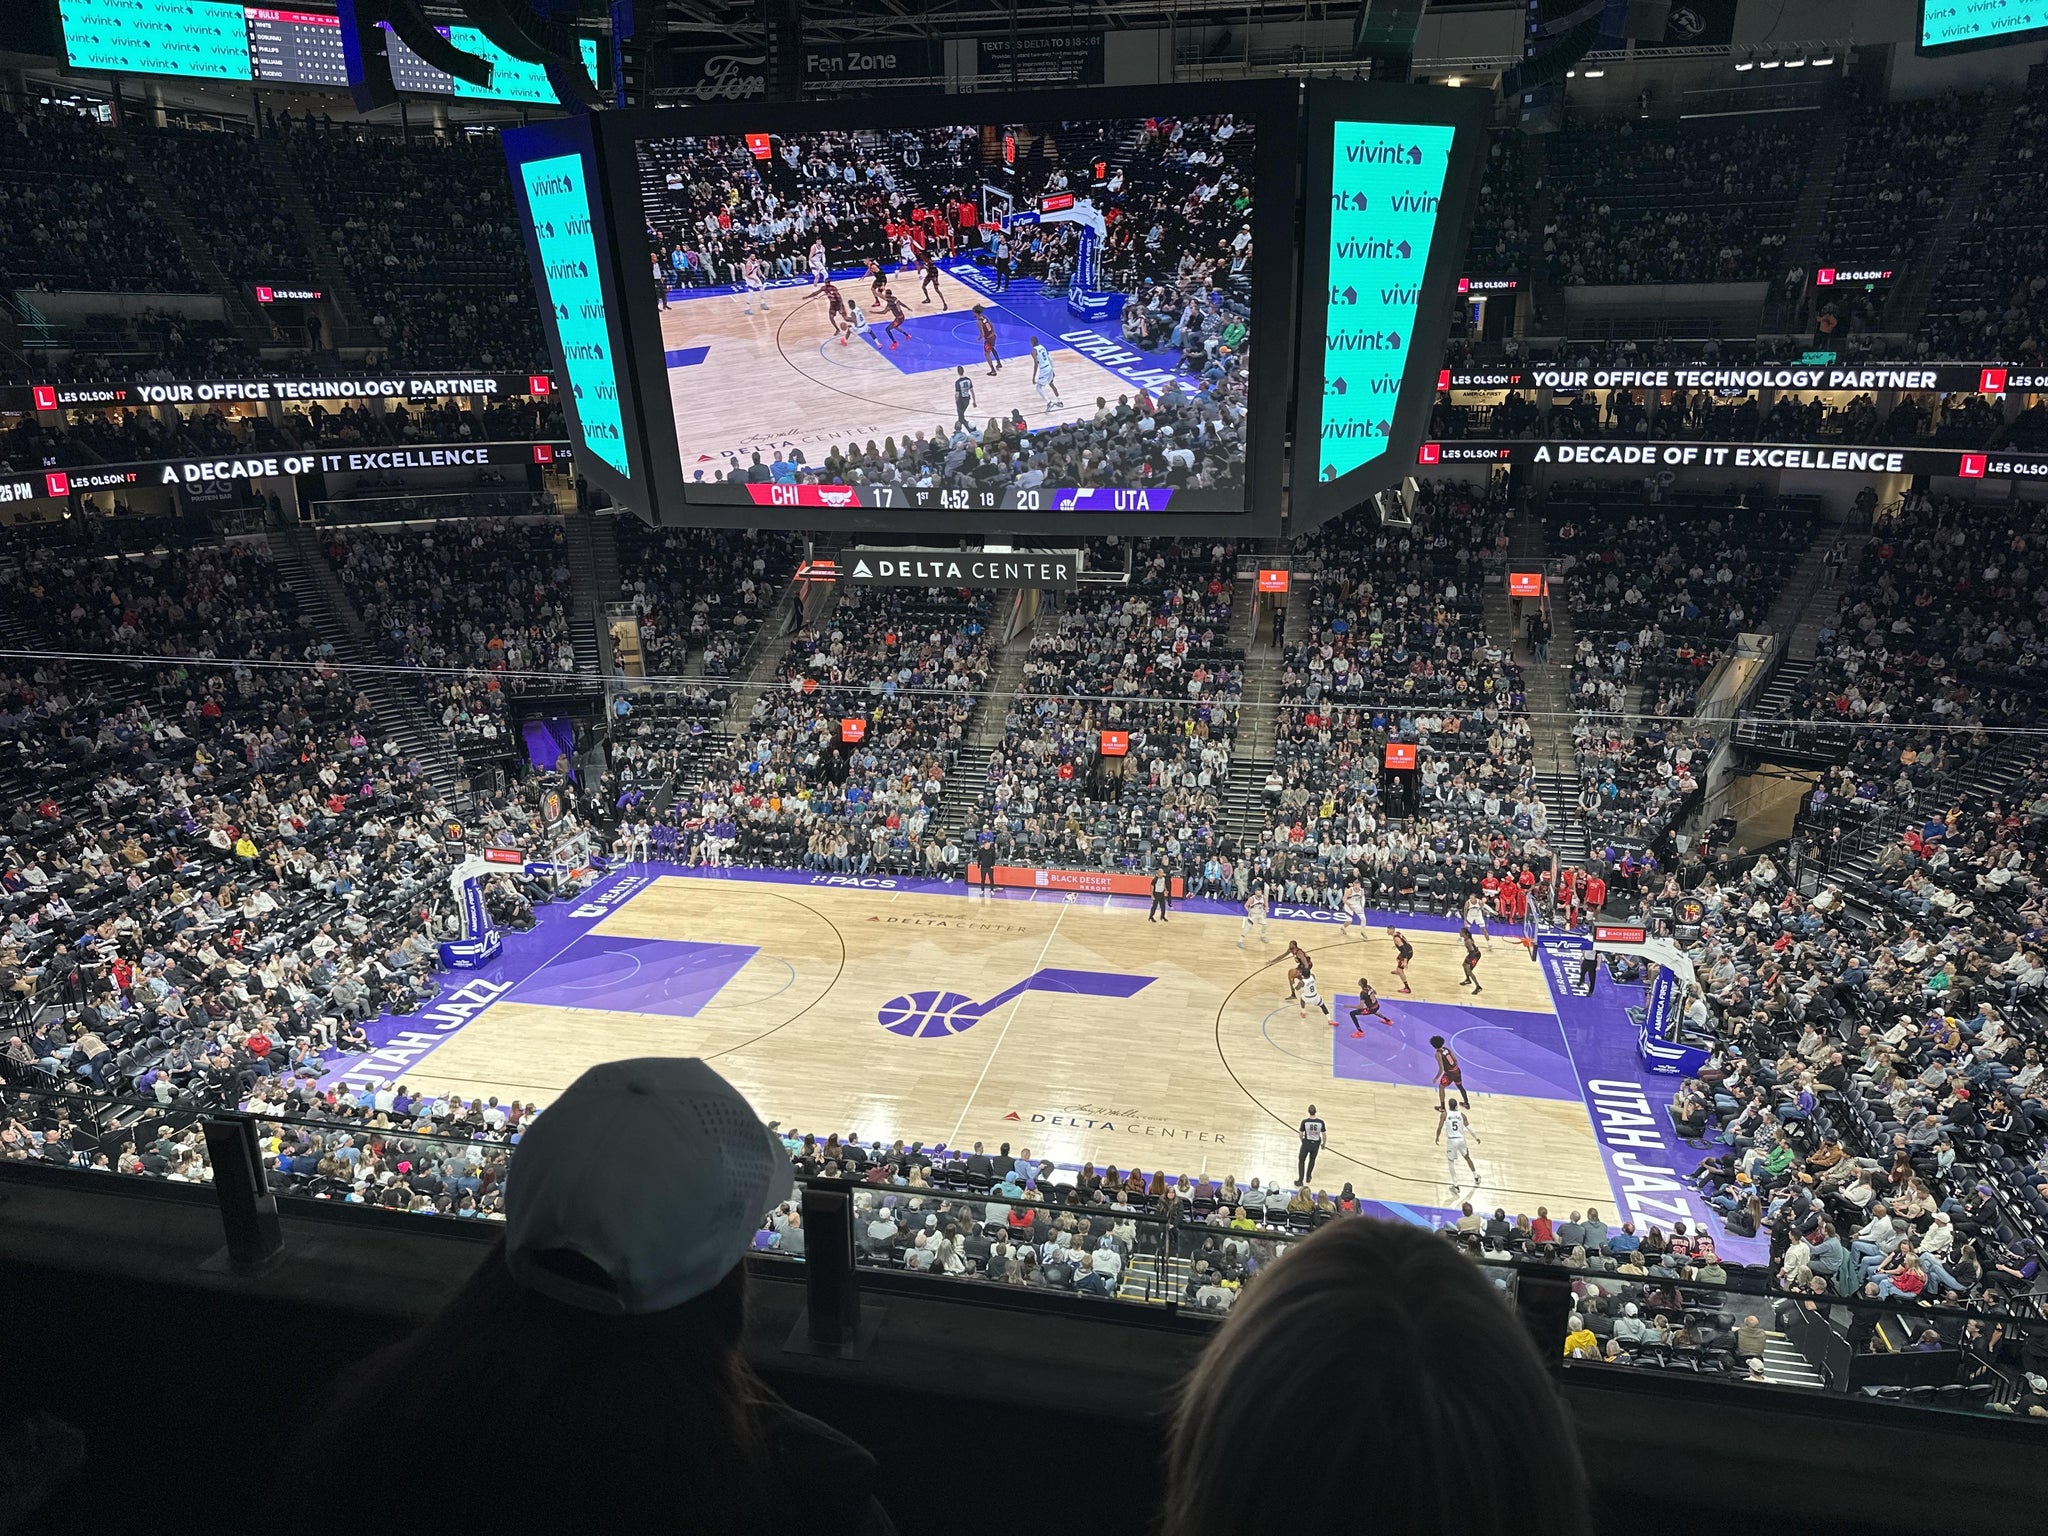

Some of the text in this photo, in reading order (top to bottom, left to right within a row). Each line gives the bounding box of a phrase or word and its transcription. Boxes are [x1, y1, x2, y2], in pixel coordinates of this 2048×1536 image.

[155, 3, 184, 14] vivint
[204, 8, 233, 18] vivint
[1967, 1, 1997, 13] vivint
[81, 15, 113, 26] vivint
[258, 10, 279, 19] BULLS
[133, 20, 164, 31] vivint
[1991, 16, 2021, 28] vivint
[183, 24, 213, 35] vivint
[1942, 24, 1971, 37] vivint
[111, 36, 142, 48] vivint
[162, 41, 192, 52] vivint
[982, 39, 1064, 51] TEXT SS DELTA TO
[211, 45, 241, 56] vivint
[88, 54, 120, 65] vivint
[139, 58, 170, 69] vivint
[807, 53, 897, 73] Fan Zone
[189, 62, 219, 73] vivint
[511, 88, 534, 97] vivint
[1347, 140, 1404, 164] vivint
[532, 174, 563, 197] vivint
[1337, 236, 1393, 258] vivint
[546, 259, 578, 280] vivint
[1836, 272, 1851, 280] LES
[1853, 271, 1882, 279] OLSON
[1326, 328, 1383, 350] vivint
[1059, 329, 1143, 366] UTAH
[1452, 375, 1472, 385] LES
[1473, 375, 1508, 385] OLSON
[1510, 375, 1521, 384] IT
[1532, 371, 1588, 387] YOUR
[1593, 371, 1668, 387] OFFICE
[1674, 370, 1824, 388] TECHNOLOGY
[1829, 371, 1937, 389] PARTNER
[2008, 376, 2031, 386] LES
[58, 392, 77, 403] LES
[79, 391, 114, 401] OLSON
[116, 391, 127, 399] IT
[137, 386, 194, 402] YOUR
[198, 383, 269, 400] OFFICE
[274, 380, 405, 398] TECHNOLOGY
[411, 379, 497, 395] PARTNER
[720, 440, 794, 458] DELTA
[802, 426, 881, 443] CENTER
[1442, 450, 1461, 458] LES
[1463, 450, 1498, 459] OLSON
[1500, 450, 1510, 458] IT
[1534, 446, 1551, 462] A
[1558, 446, 1656, 464] DECADE
[1663, 448, 1698, 465] OF
[1704, 449, 1728, 465] IT
[1735, 449, 1903, 472] EXCELLENCE
[1988, 462, 2011, 473] LES
[14, 482, 33, 500] PM
[70, 478, 89, 488] LES
[91, 474, 125, 486] OLSON
[126, 473, 137, 482] IT
[162, 465, 181, 484] A
[184, 459, 279, 483] DECADE
[284, 457, 315, 475] OF
[321, 455, 341, 472] IT
[350, 449, 489, 470] EXCELLENCE
[555, 450, 572, 458] LES
[191, 493, 219, 502] PROTEIN
[771, 486, 1149, 510] CHI 17 1ST 4:52 18 20 UTA
[879, 560, 1068, 581] DELTA CENTER
[827, 876, 897, 888] PACS
[1051, 874, 1111, 885] BLACK DESERT
[594, 876, 640, 903] HEALTH
[1274, 907, 1353, 922] PACS
[887, 916, 1027, 933] DELTA CENTER
[1655, 980, 1668, 1031] AMERICA FIRST
[329, 978, 514, 1091] UTAH JAZZ
[1031, 1114, 1226, 1144] DELTA CENTER
[1452, 1121, 1458, 1131] 5
[1588, 1079, 1696, 1236] UTAH JAZZ
